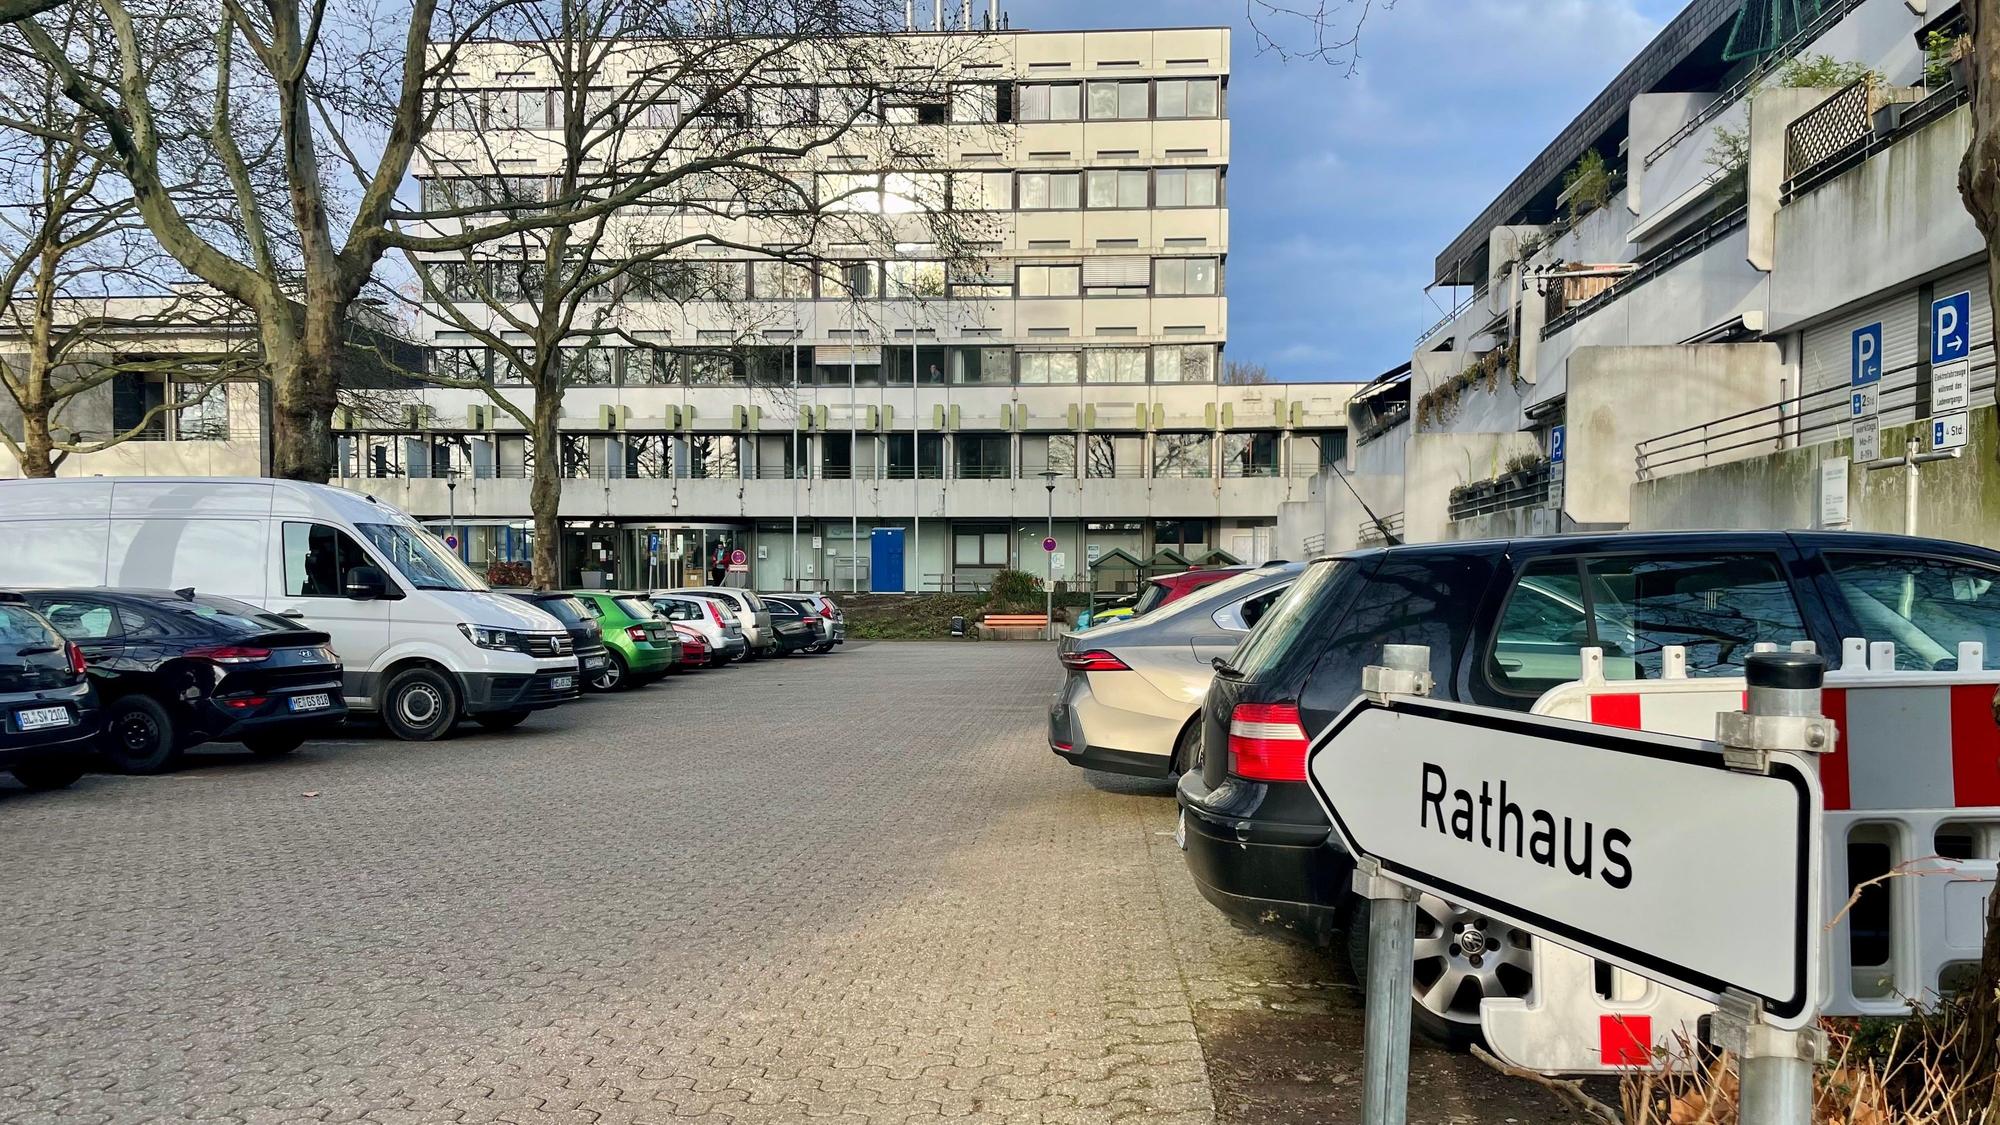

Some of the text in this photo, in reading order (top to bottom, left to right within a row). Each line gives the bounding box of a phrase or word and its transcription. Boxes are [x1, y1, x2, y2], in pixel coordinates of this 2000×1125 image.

[1937, 305, 1958, 356] P
[1858, 333, 1874, 378] P
[1862, 394, 1867, 407] 2
[1553, 431, 1561, 458] P
[293, 694, 329, 708] ME GS 818
[22, 709, 67, 724] GL SW 2101
[1420, 761, 1633, 890] Rathaus
